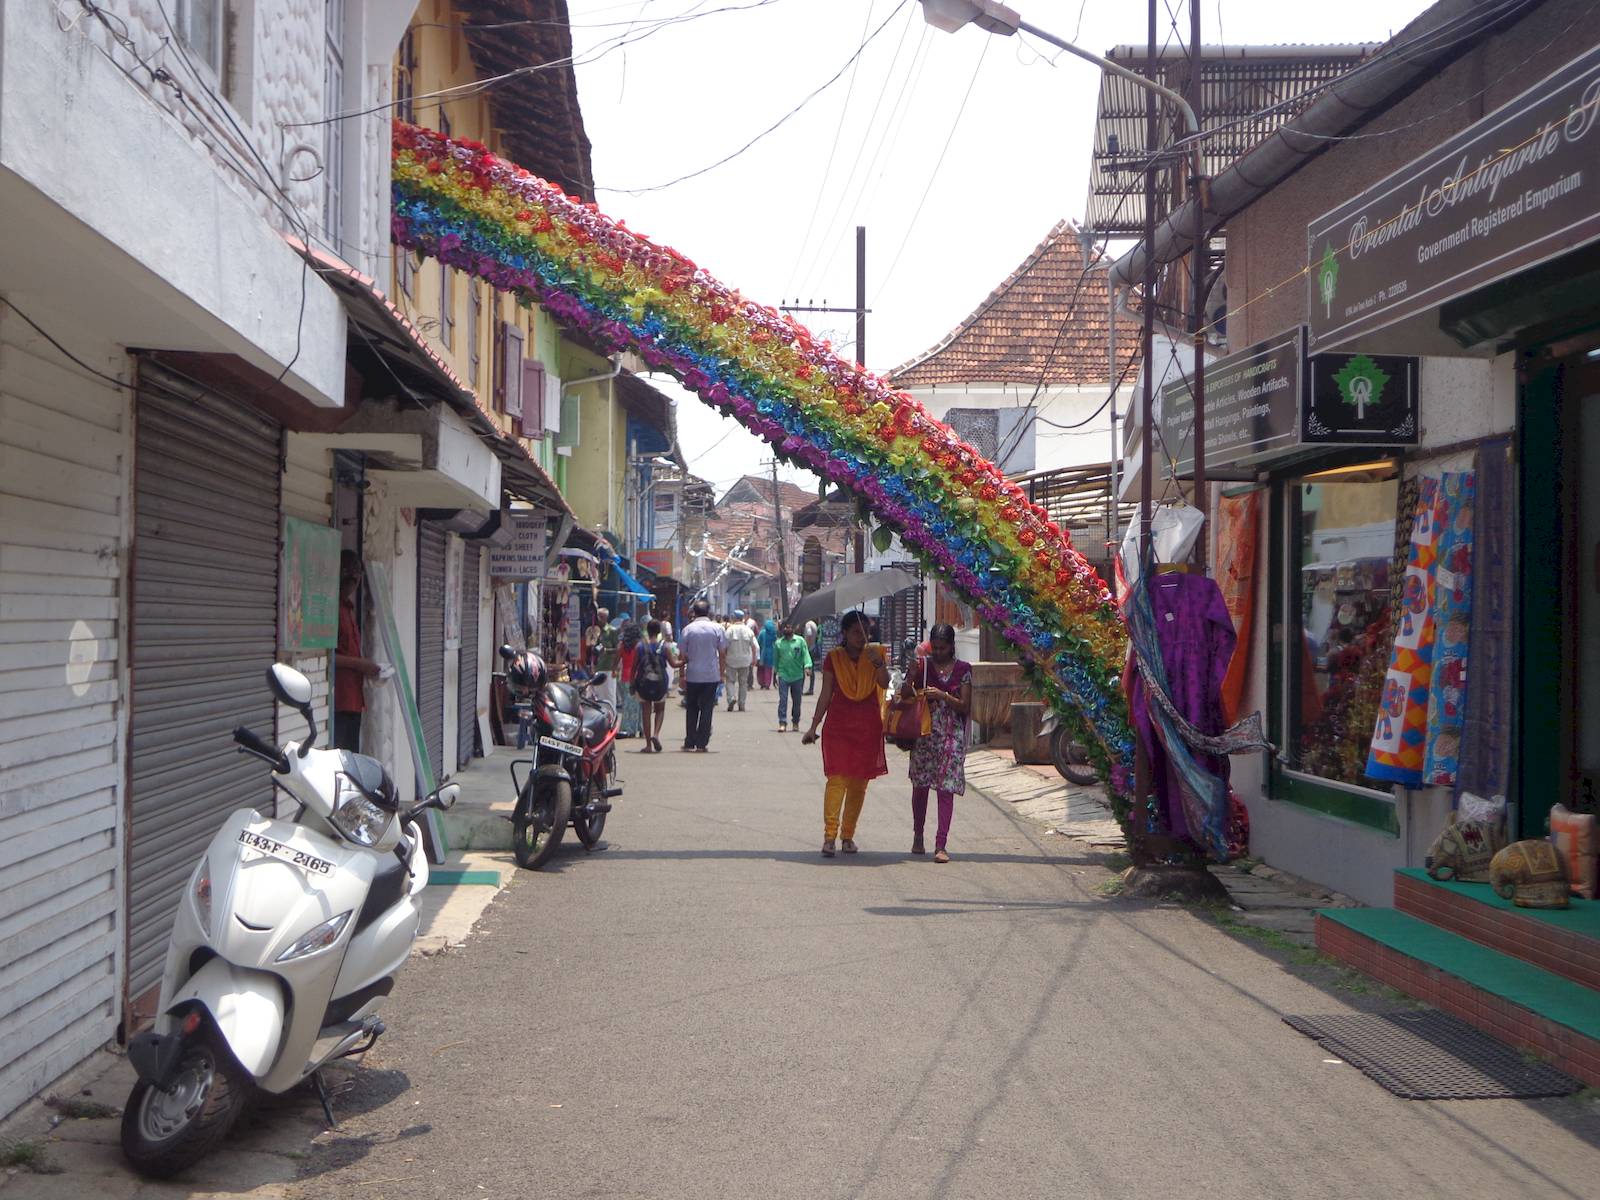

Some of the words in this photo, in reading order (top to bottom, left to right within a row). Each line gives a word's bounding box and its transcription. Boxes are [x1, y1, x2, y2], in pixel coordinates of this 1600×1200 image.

[1348, 185, 1427, 259] Oriental
[1417, 221, 1470, 264] Government
[1471, 194, 1523, 237] Registered
[1525, 171, 1582, 211] Emporium
[1234, 371, 1242, 383] OF
[1243, 359, 1277, 379] HANDICRAFTS
[1238, 385, 1261, 401] Wooden
[1262, 376, 1289, 394] Artifacts,
[518, 532, 538, 540] CLOTH
